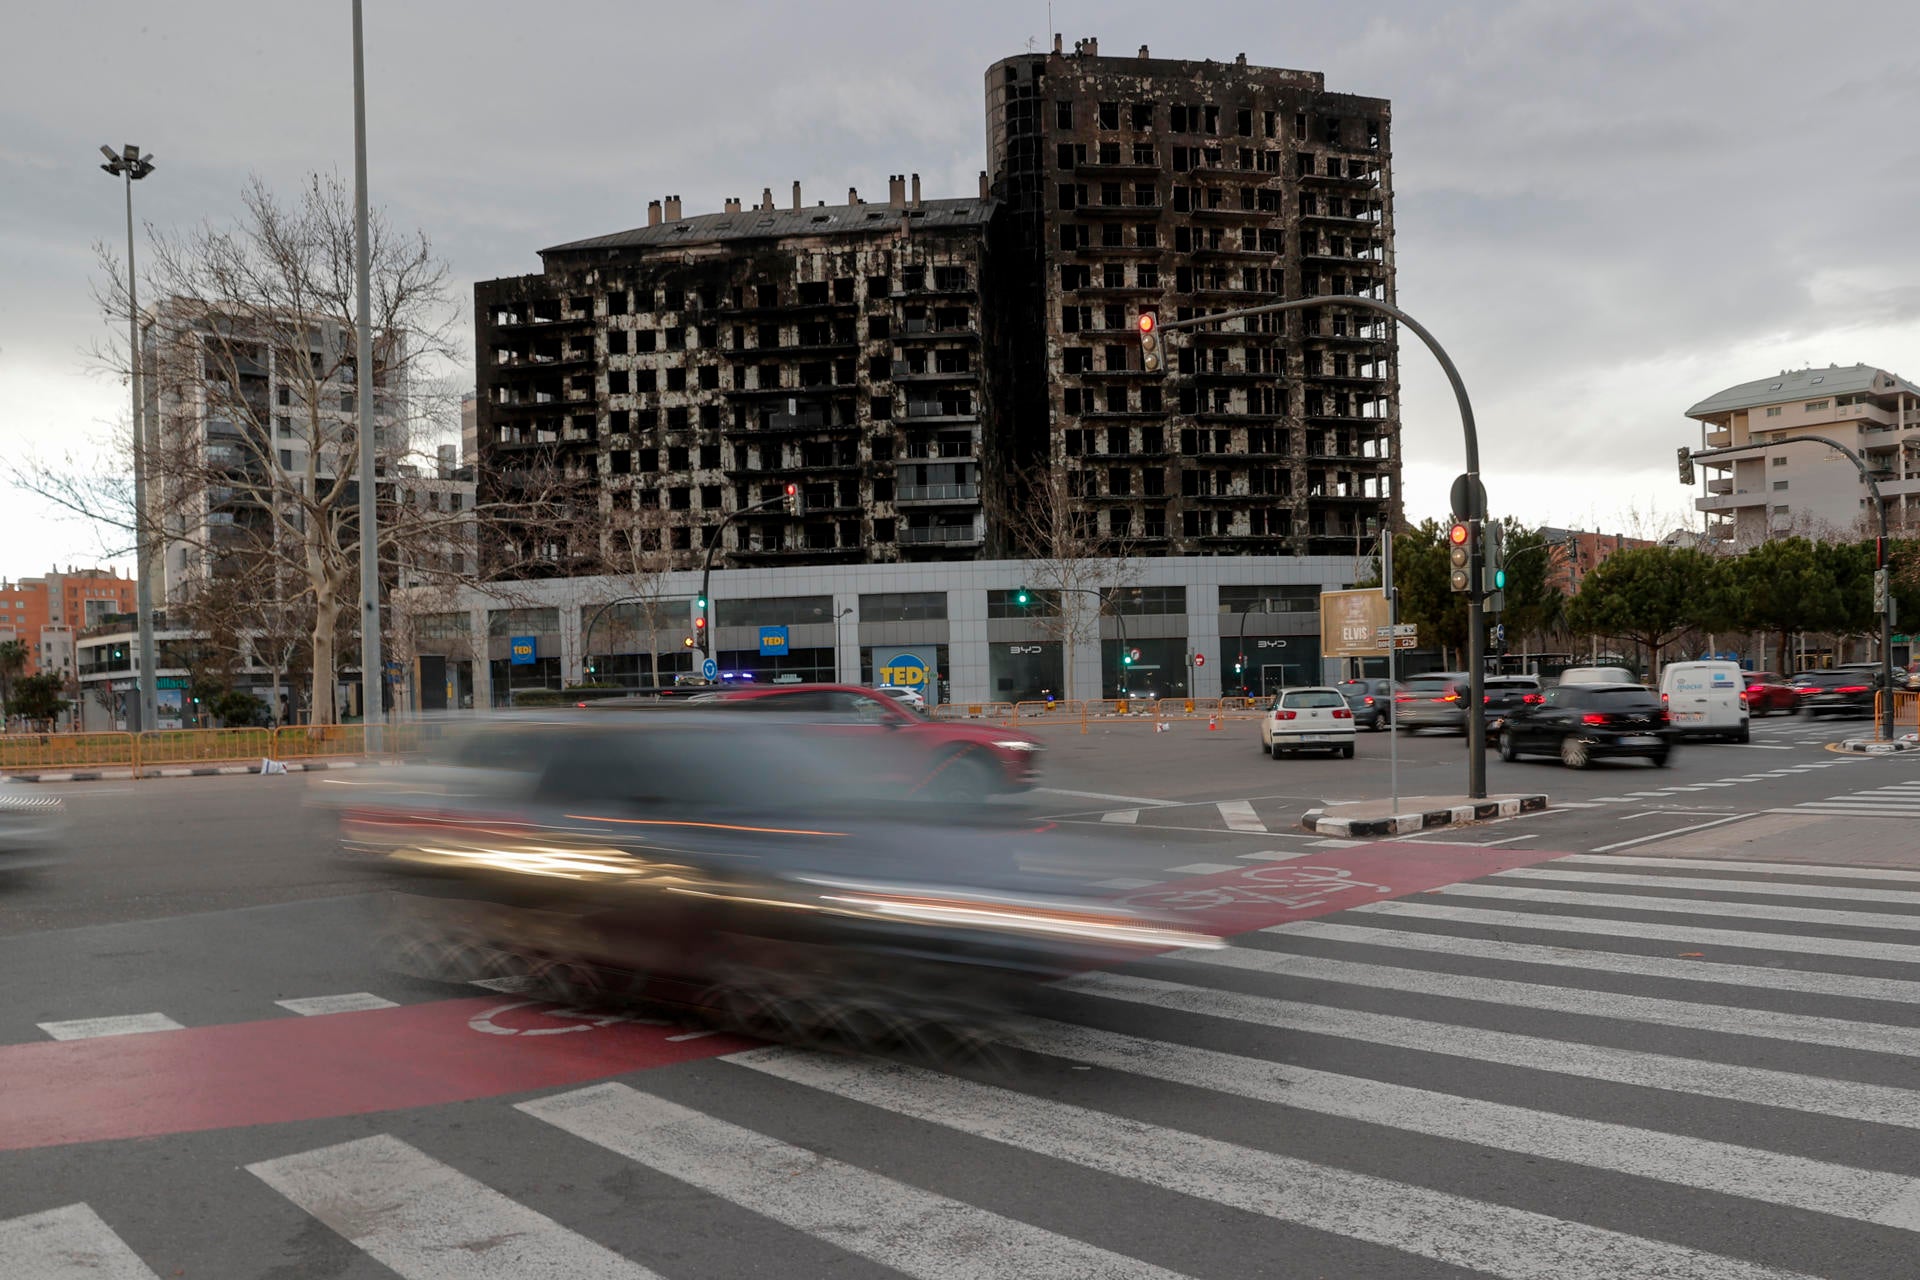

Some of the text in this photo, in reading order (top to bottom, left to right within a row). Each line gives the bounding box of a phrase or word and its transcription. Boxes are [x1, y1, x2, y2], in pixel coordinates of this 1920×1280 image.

[1343, 627, 1367, 640] ELVIS
[763, 637, 784, 645] TEDi
[1257, 640, 1287, 648] BYD
[514, 646, 531, 654] TEDi
[1010, 645, 1042, 654] BYD
[880, 666, 930, 685] TEDi
